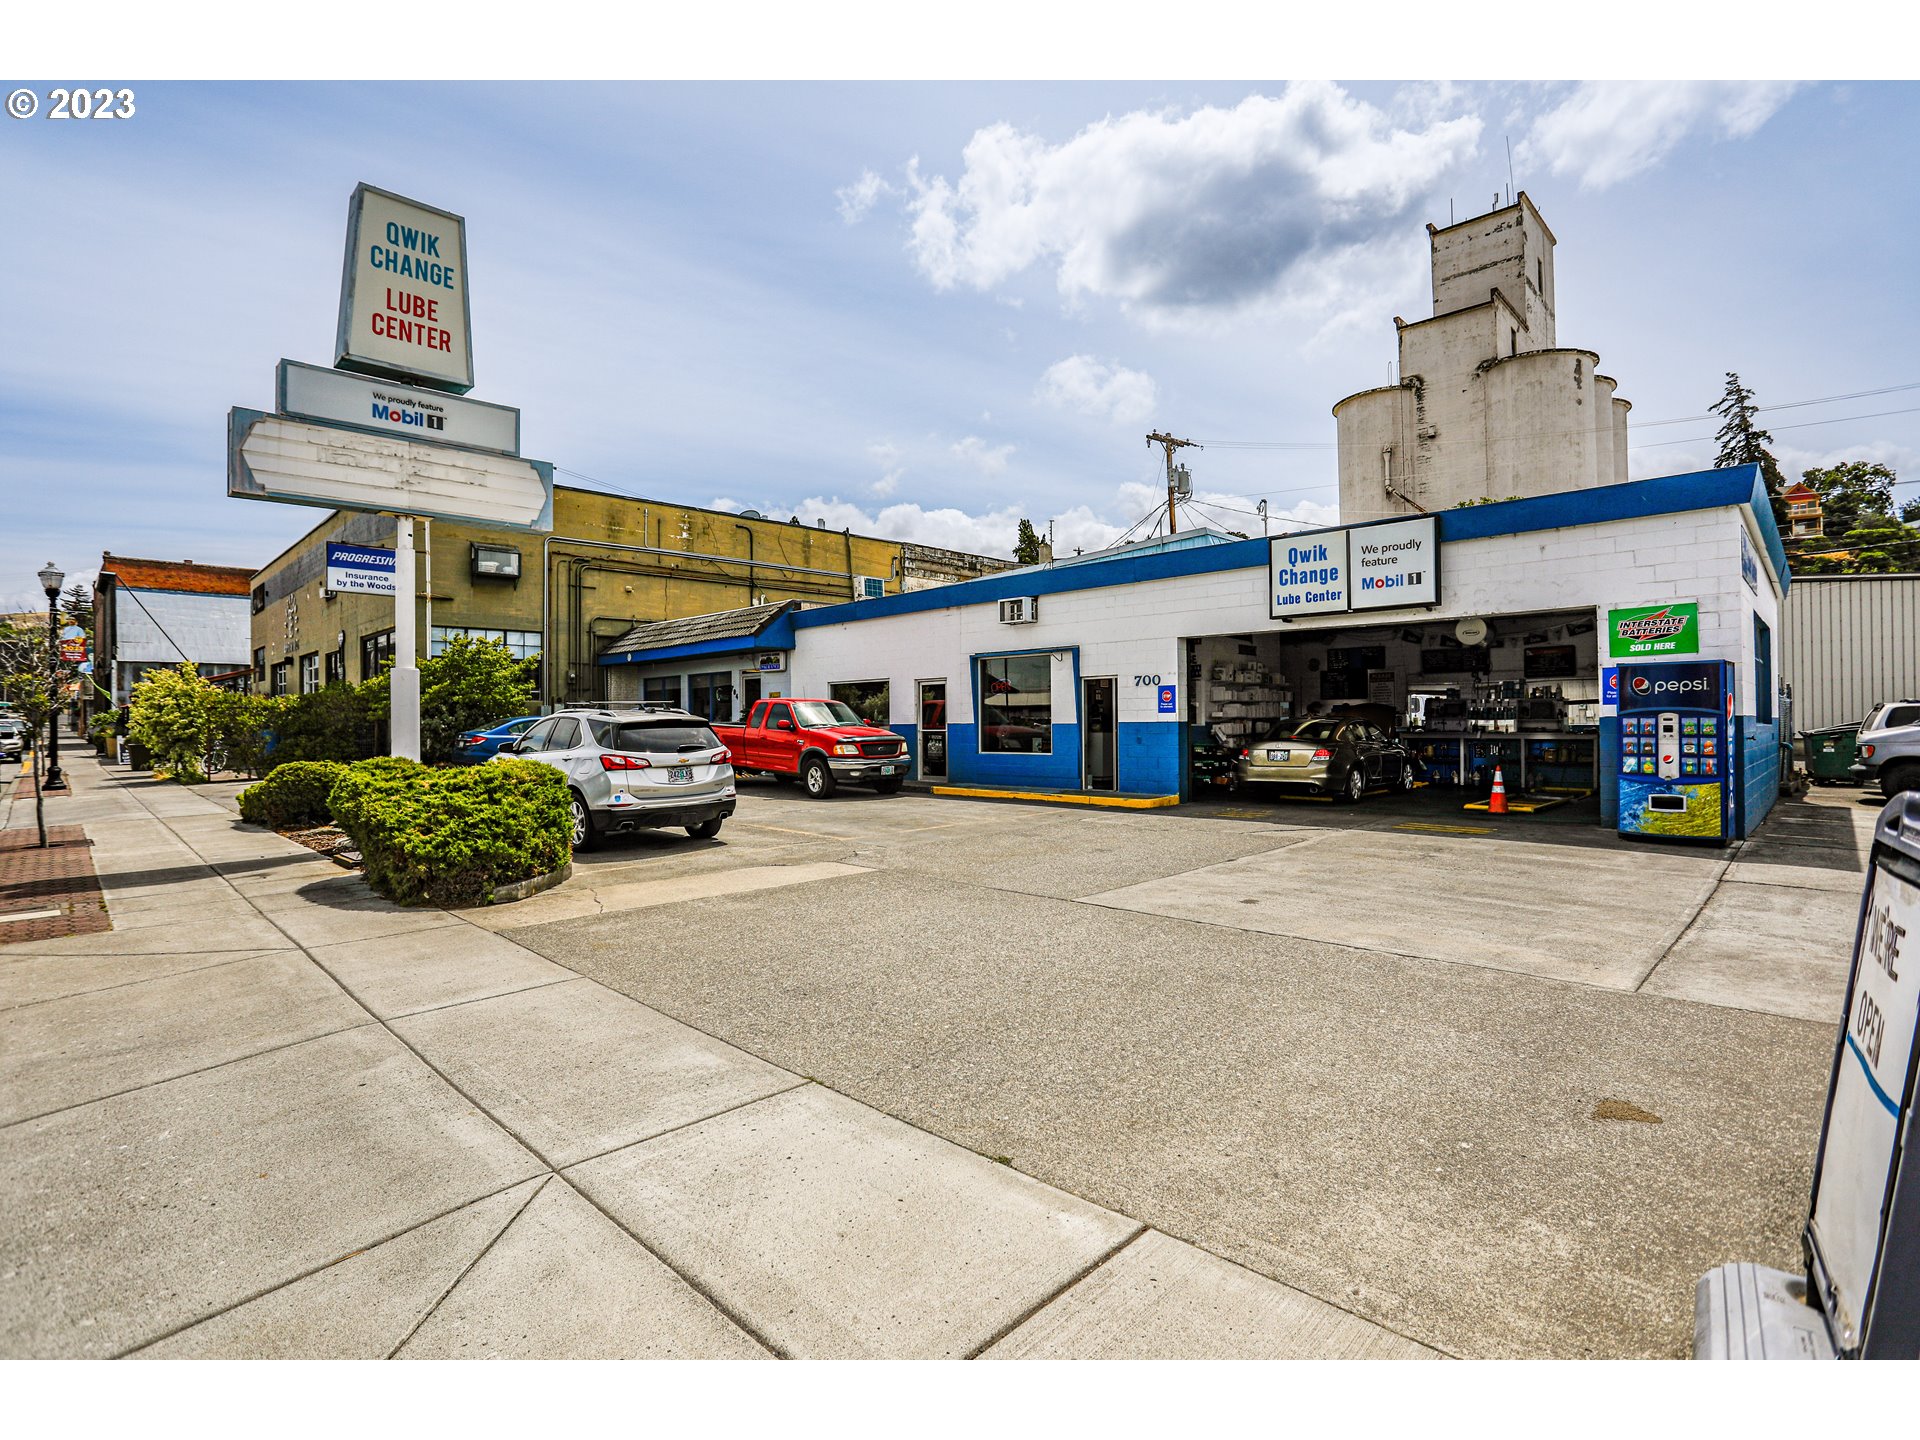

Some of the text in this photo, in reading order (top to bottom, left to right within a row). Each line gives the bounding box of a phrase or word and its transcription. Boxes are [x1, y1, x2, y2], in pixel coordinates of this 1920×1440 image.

[386, 221, 440, 258] QWIK
[370, 245, 454, 290] CHANGE
[386, 287, 439, 323] LUBE
[371, 312, 451, 353] CENTER
[372, 391, 444, 413] We proudly feature
[372, 403, 424, 427] Mobil
[1288, 544, 1328, 568] Qwik
[1361, 539, 1422, 556] We proudly
[331, 551, 396, 566] PROGRESSIV
[1361, 556, 1398, 568] feature
[336, 579, 347, 588] by
[350, 579, 365, 588] the
[345, 571, 389, 582] Insurance
[1279, 567, 1339, 587] Change
[1362, 574, 1404, 590] Mobil
[1276, 590, 1342, 606] Lube Center
[1619, 616, 1686, 630] INTERSTATE
[1620, 625, 1680, 637] BATTERIES
[1629, 641, 1676, 652] SOLD HERE
[1134, 674, 1161, 687] 700
[1654, 677, 1708, 694] pepsi
[1869, 905, 1906, 983] WE'RE
[1857, 989, 1885, 1070] OPEN
